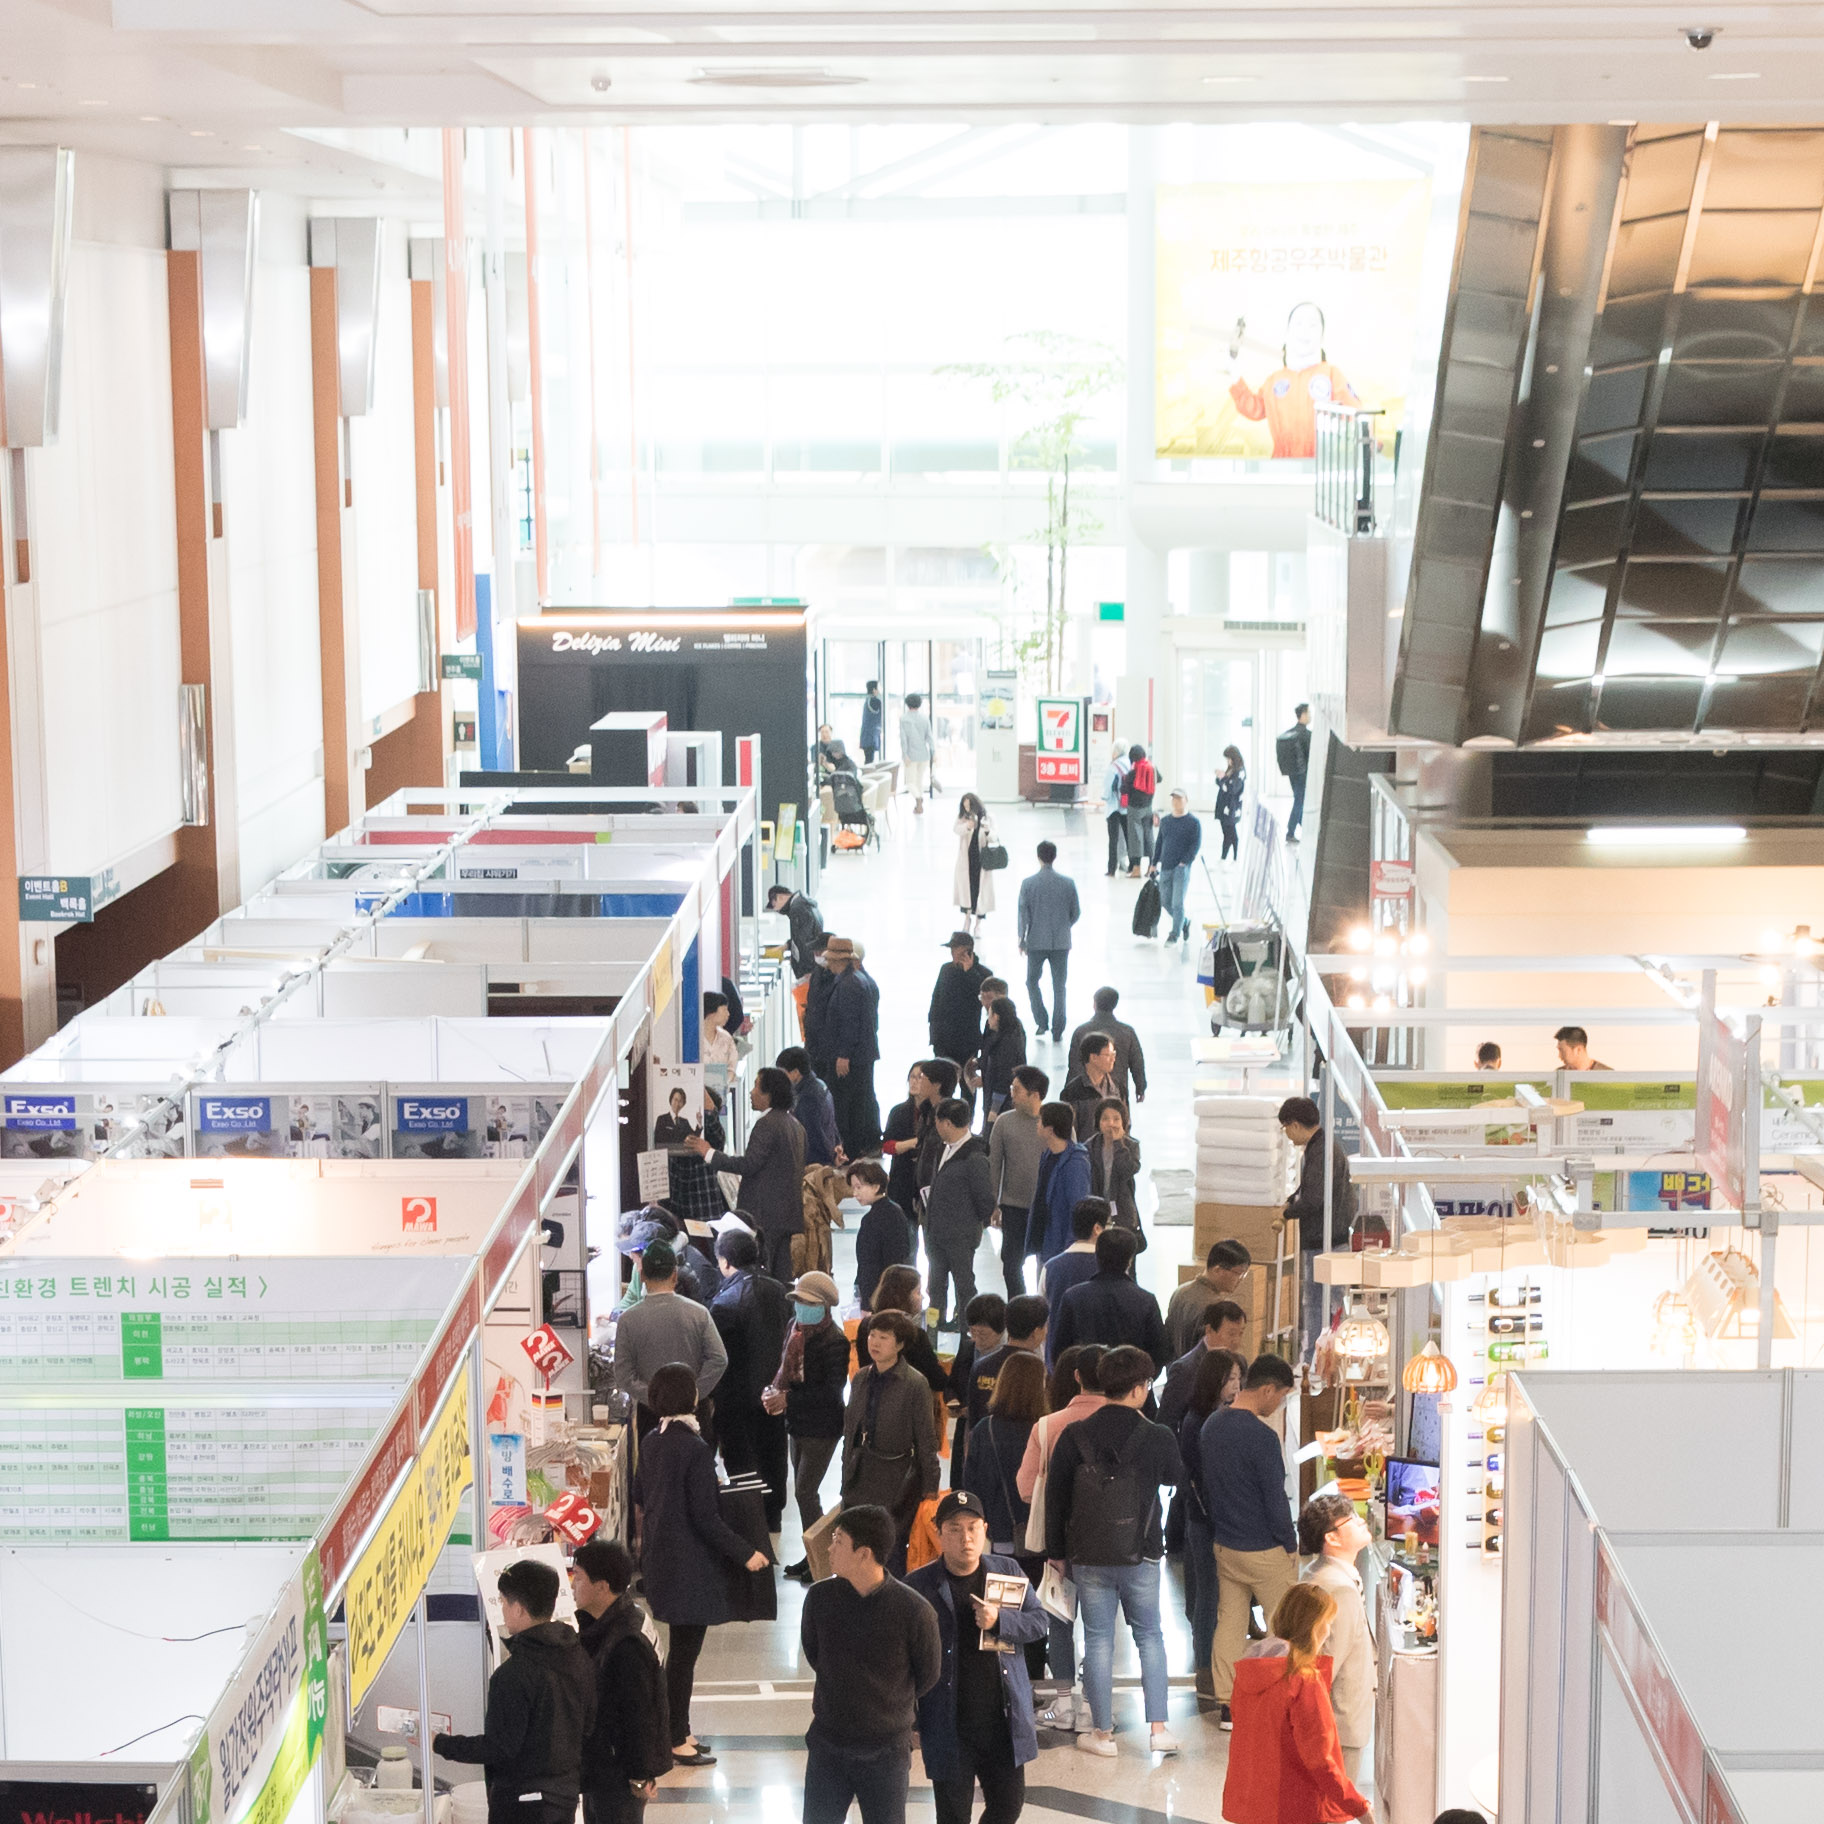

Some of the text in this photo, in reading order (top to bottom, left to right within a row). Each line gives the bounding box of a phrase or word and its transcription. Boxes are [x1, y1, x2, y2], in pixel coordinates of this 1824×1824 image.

[1210, 245, 1389, 273] 제주항공우주박물관
[552, 631, 682, 656] Delizia Mini
[207, 1101, 265, 1121] Exso
[403, 1102, 462, 1120] Exso
[16, 1118, 34, 1127] Exso
[211, 1120, 229, 1130] Exso
[408, 1120, 426, 1128] Exso
[403, 1221, 436, 1233] MAWA
[69, 1275, 136, 1300] 트렌치
[148, 1275, 192, 1299] 시공
[204, 1275, 248, 1299] 실적
[500, 1464, 514, 1500] 배수로
